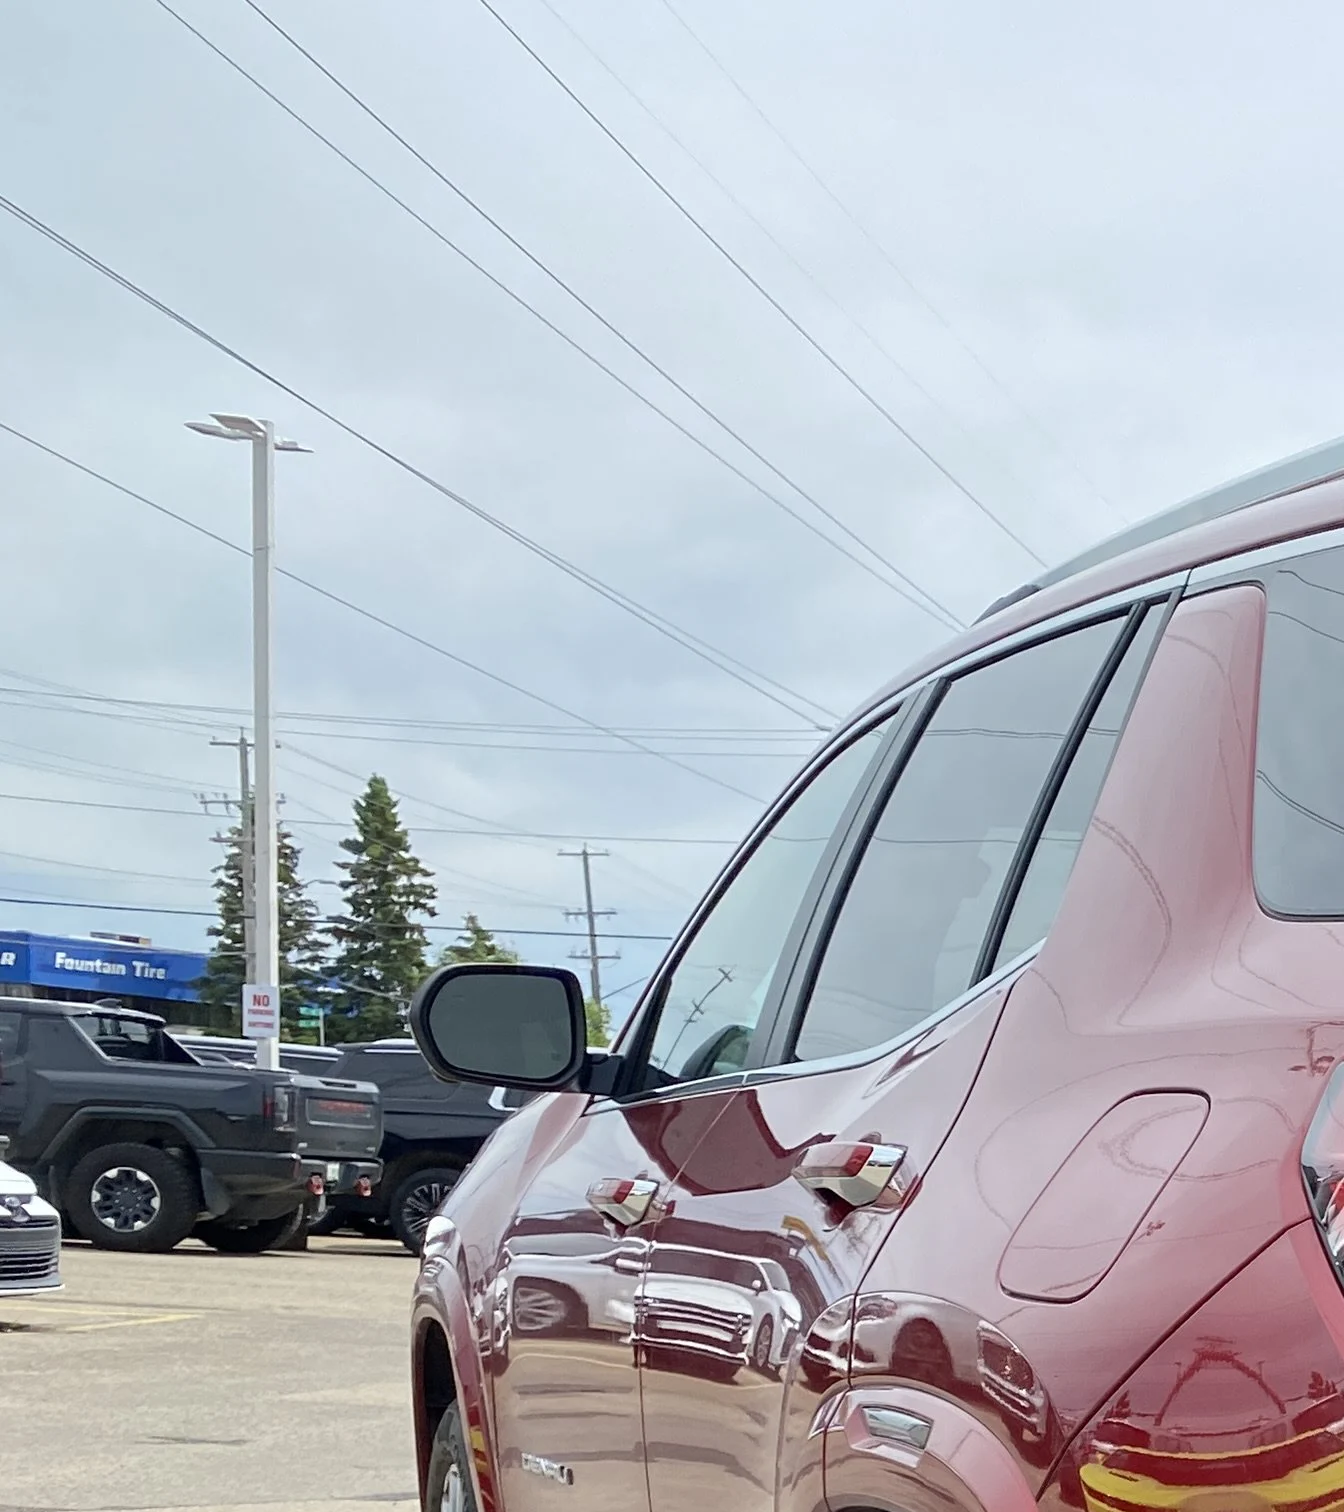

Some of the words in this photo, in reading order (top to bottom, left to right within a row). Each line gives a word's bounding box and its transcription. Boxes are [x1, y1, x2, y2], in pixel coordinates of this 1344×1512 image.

[55, 951, 126, 976] Fountain
[132, 960, 166, 980] Tire
[252, 994, 270, 1008] NO
